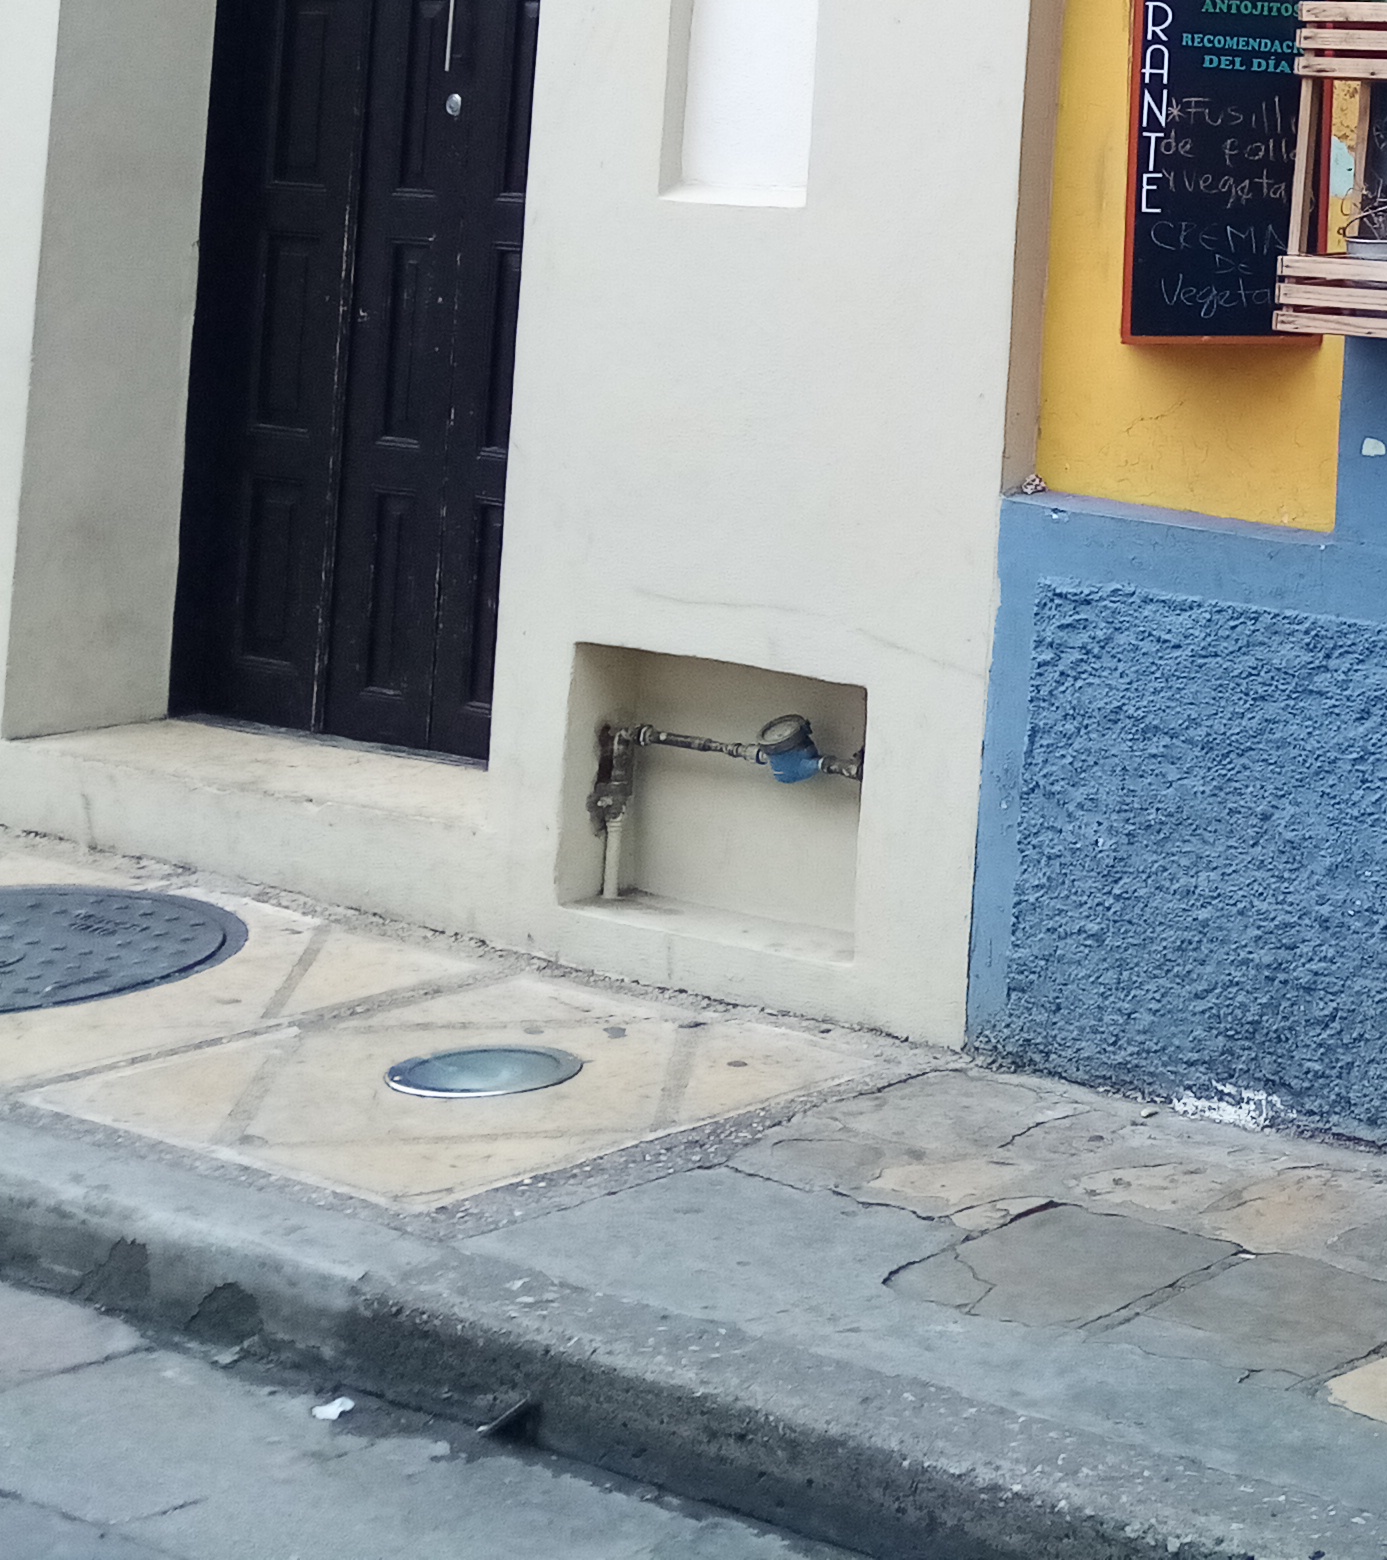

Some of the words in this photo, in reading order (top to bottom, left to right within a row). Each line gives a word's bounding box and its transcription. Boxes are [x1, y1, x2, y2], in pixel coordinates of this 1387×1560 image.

[1181, 33, 1304, 54] RECOMENDACI
[1202, 55, 1246, 70] DEL
[1160, 129, 1195, 158] de
